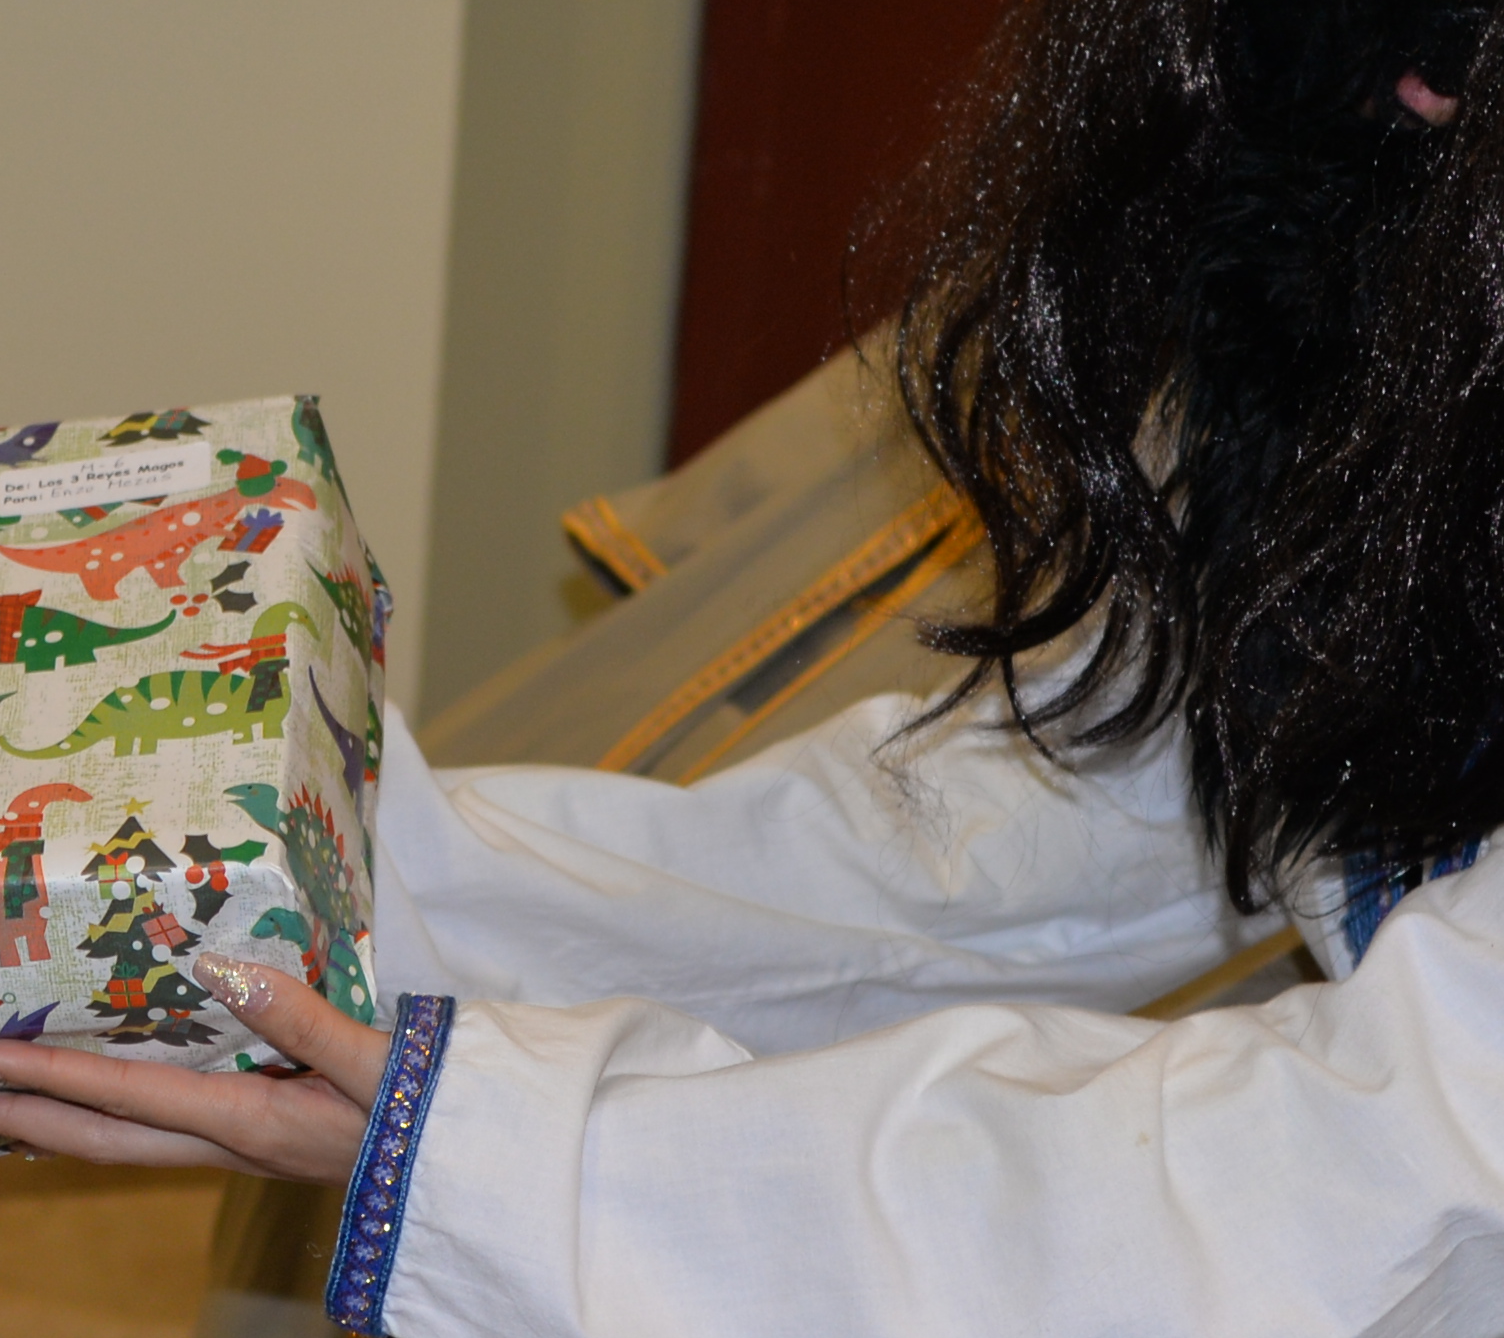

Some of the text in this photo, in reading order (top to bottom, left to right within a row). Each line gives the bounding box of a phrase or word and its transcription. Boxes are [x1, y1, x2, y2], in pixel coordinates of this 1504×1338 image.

[5, 460, 184, 493] De: Los 3 Reyes Magos
[3, 494, 43, 505] Para:
